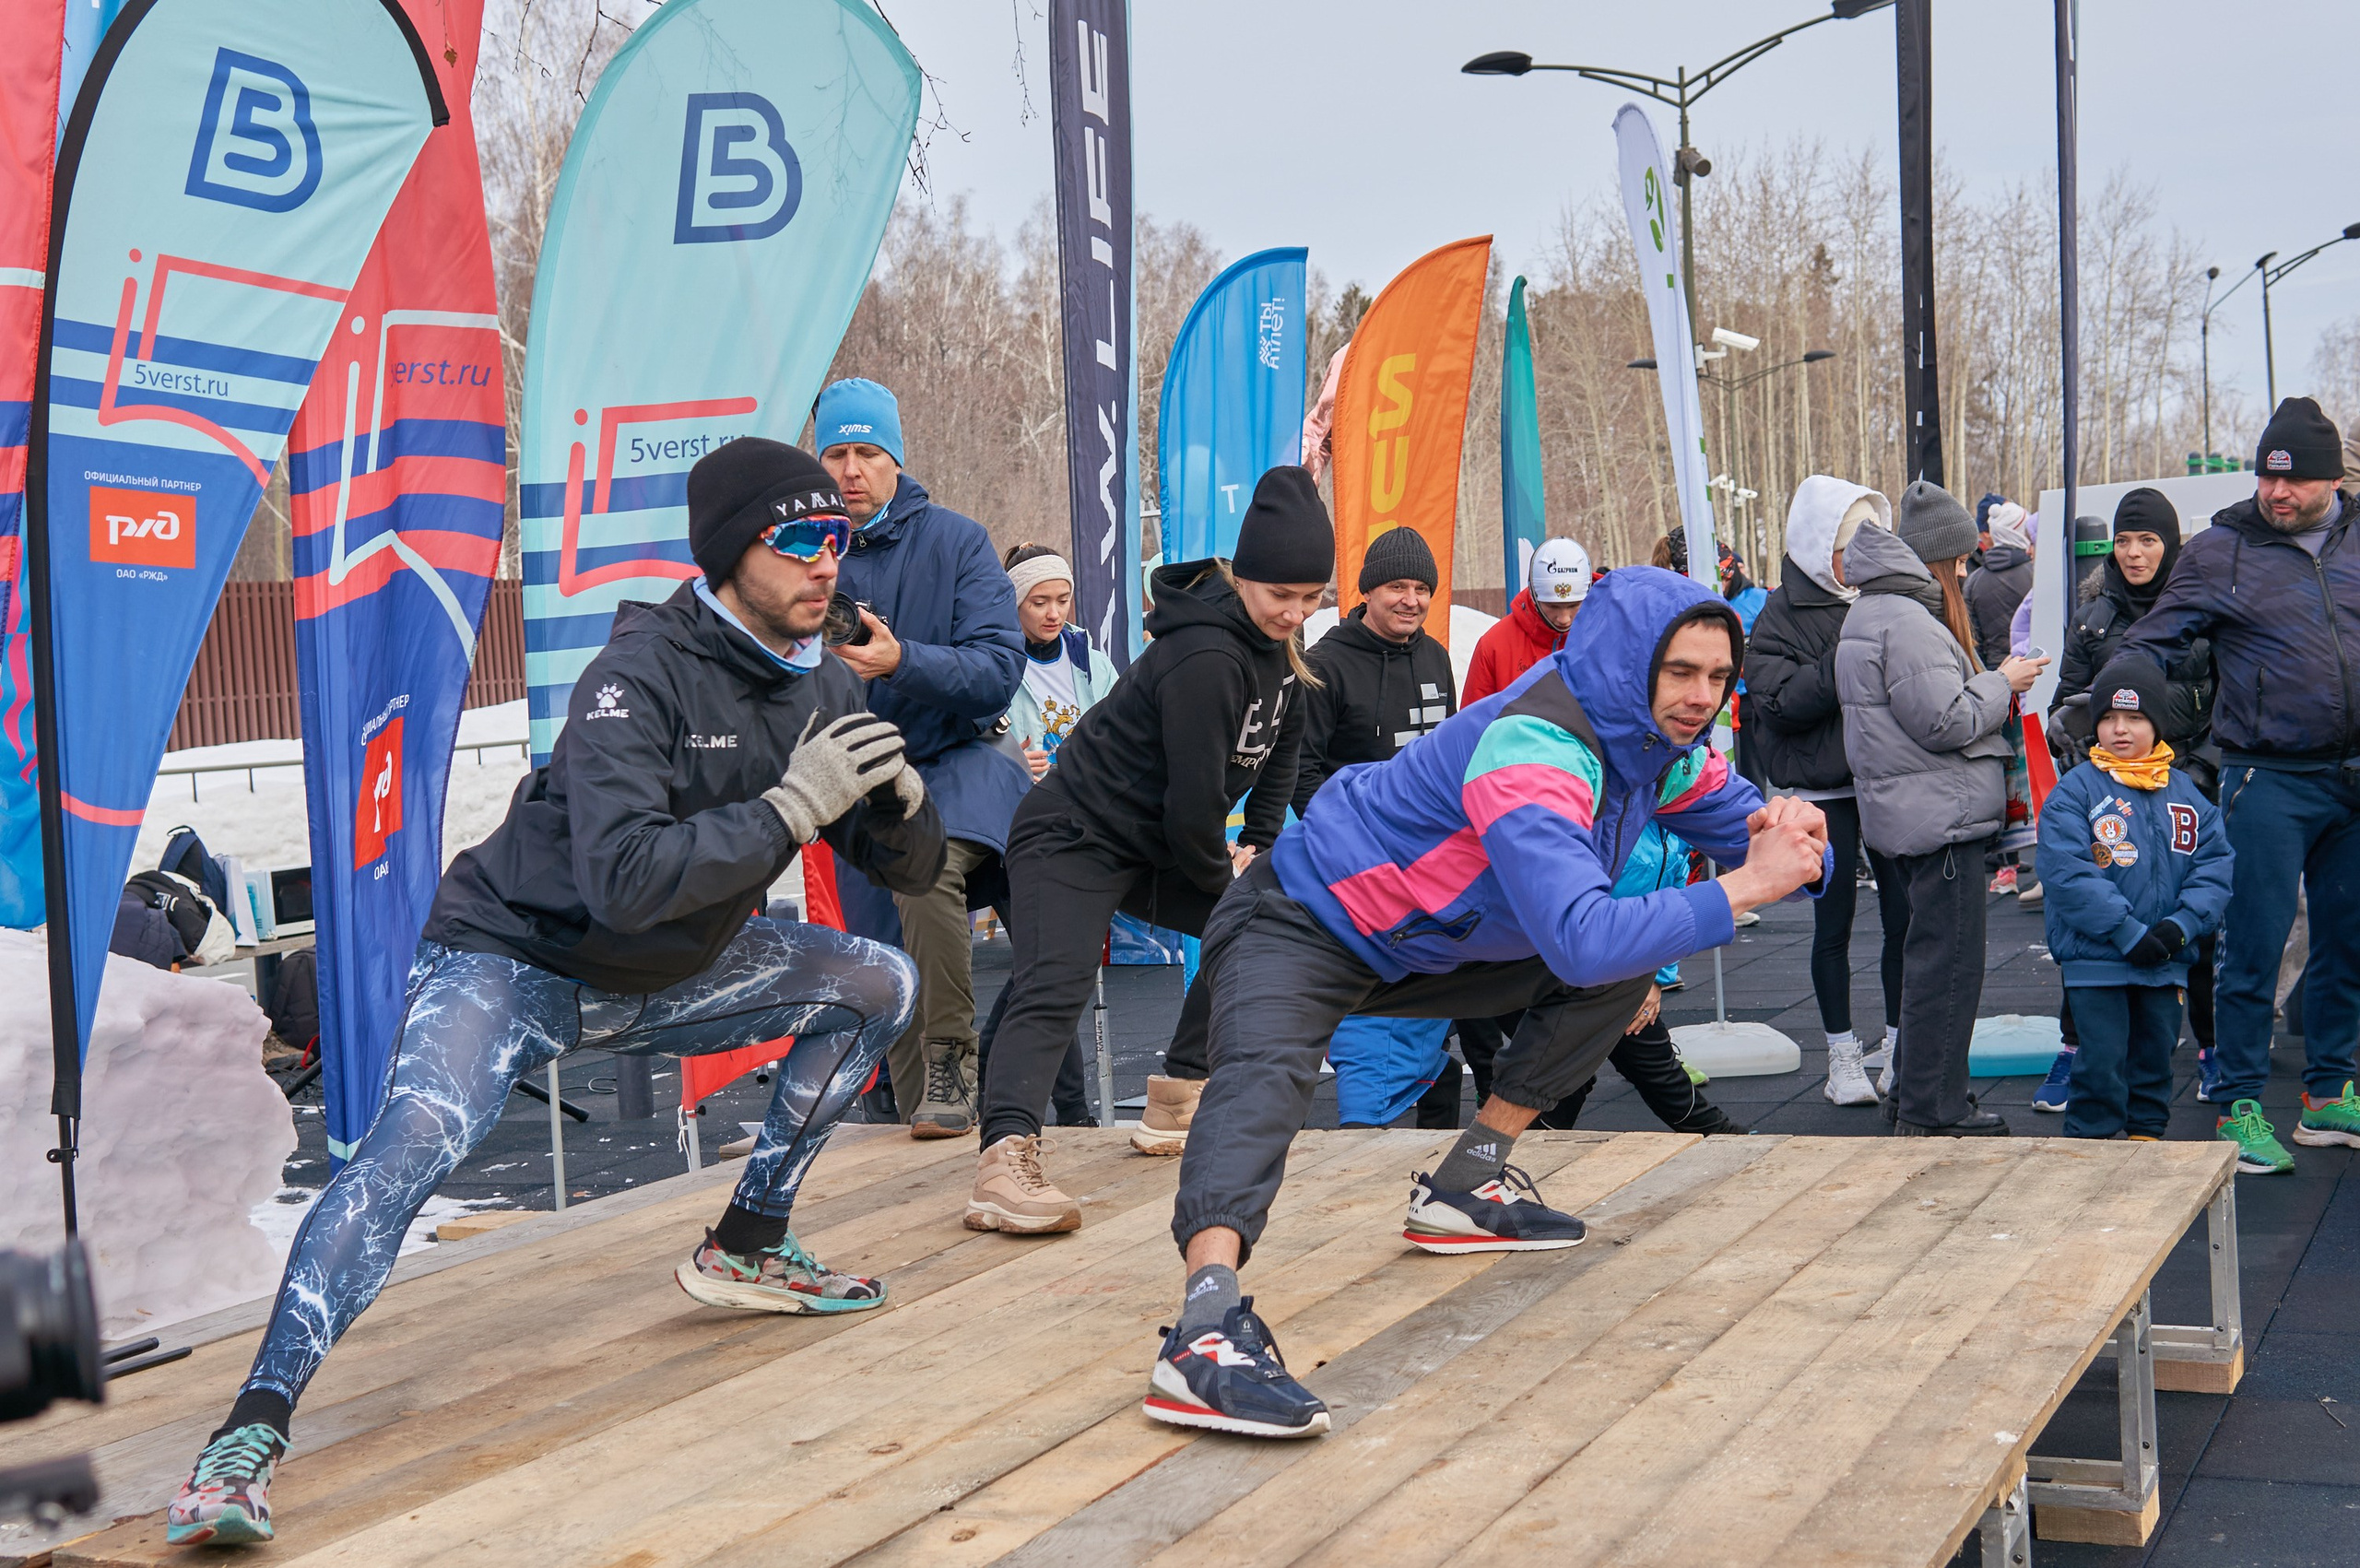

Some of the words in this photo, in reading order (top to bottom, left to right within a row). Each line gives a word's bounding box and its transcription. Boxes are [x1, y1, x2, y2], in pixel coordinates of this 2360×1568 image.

[134, 363, 229, 396] 5verst.ru
[84, 470, 159, 488] ОФИЦИАЛЬНЫЙ
[160, 478, 202, 491] ПАРТНЕР
[116, 569, 136, 579] ОАО
[138, 571, 169, 582] «РЖД»
[585, 708, 630, 721] KELME
[684, 734, 738, 749] KELME
[2166, 802, 2200, 855] B
[1466, 1148, 1497, 1162] adidas
